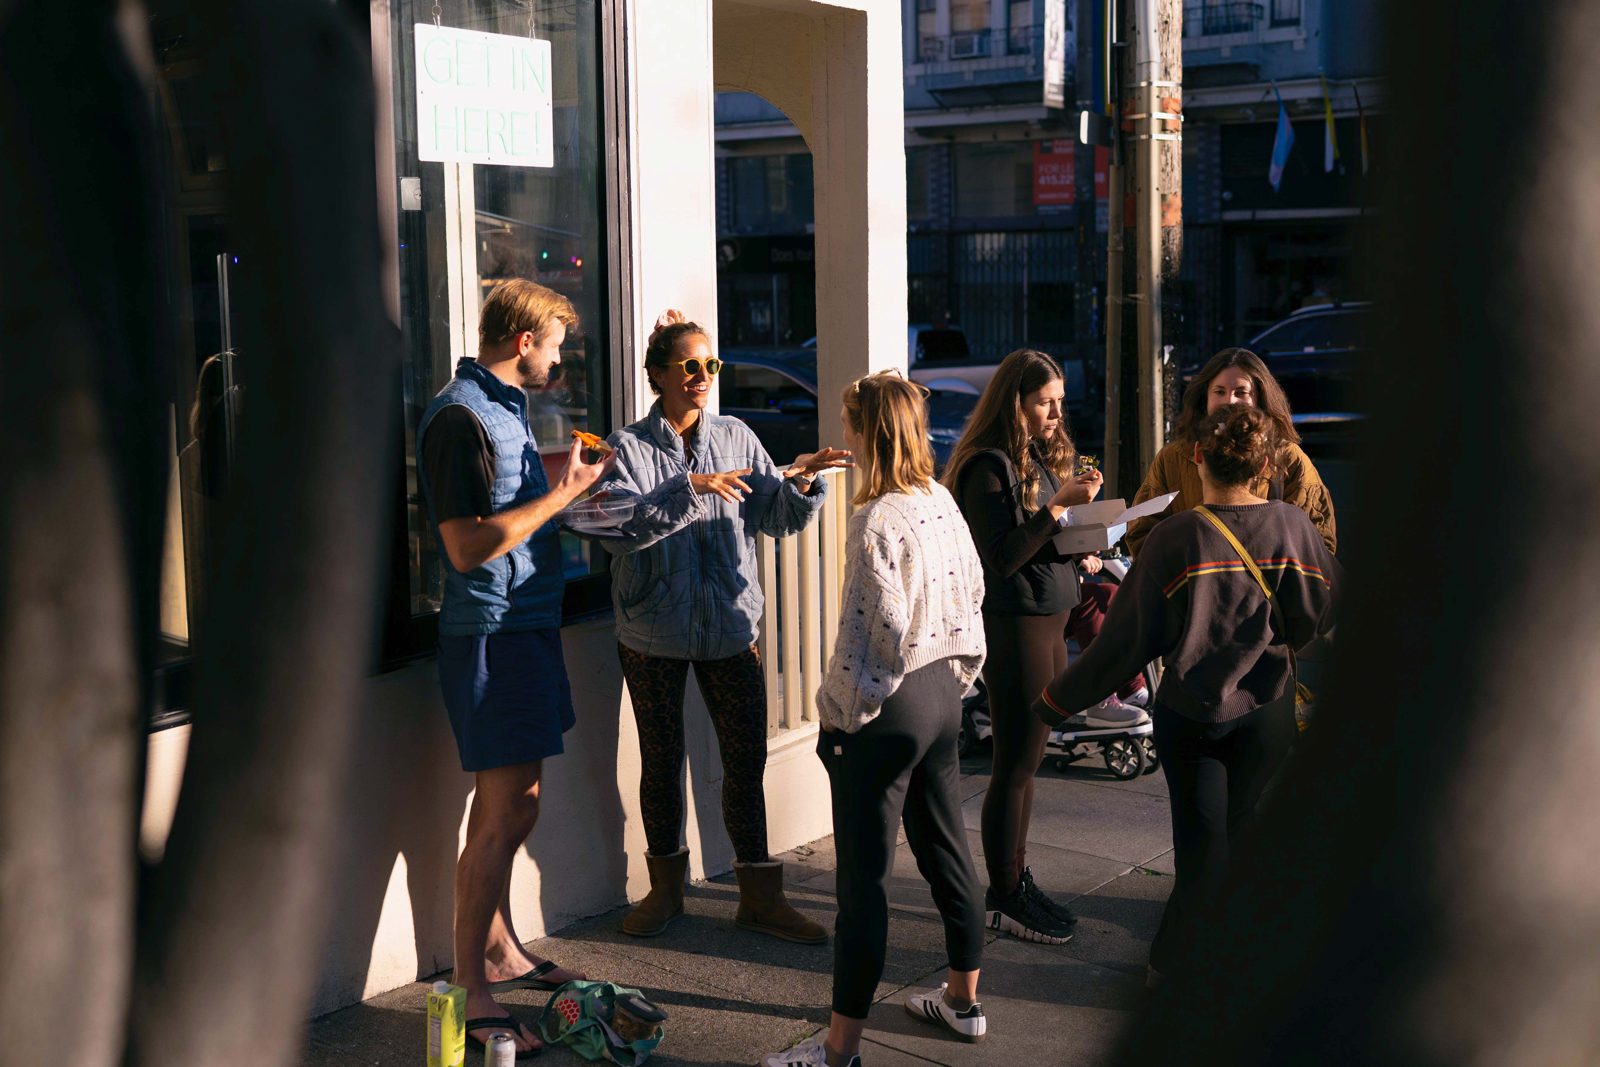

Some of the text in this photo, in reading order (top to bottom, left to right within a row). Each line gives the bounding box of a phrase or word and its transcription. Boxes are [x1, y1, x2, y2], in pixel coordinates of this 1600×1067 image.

[423, 35, 546, 93] GET IN
[433, 103, 540, 156] HERE!
[1038, 163, 1059, 174] FOR
